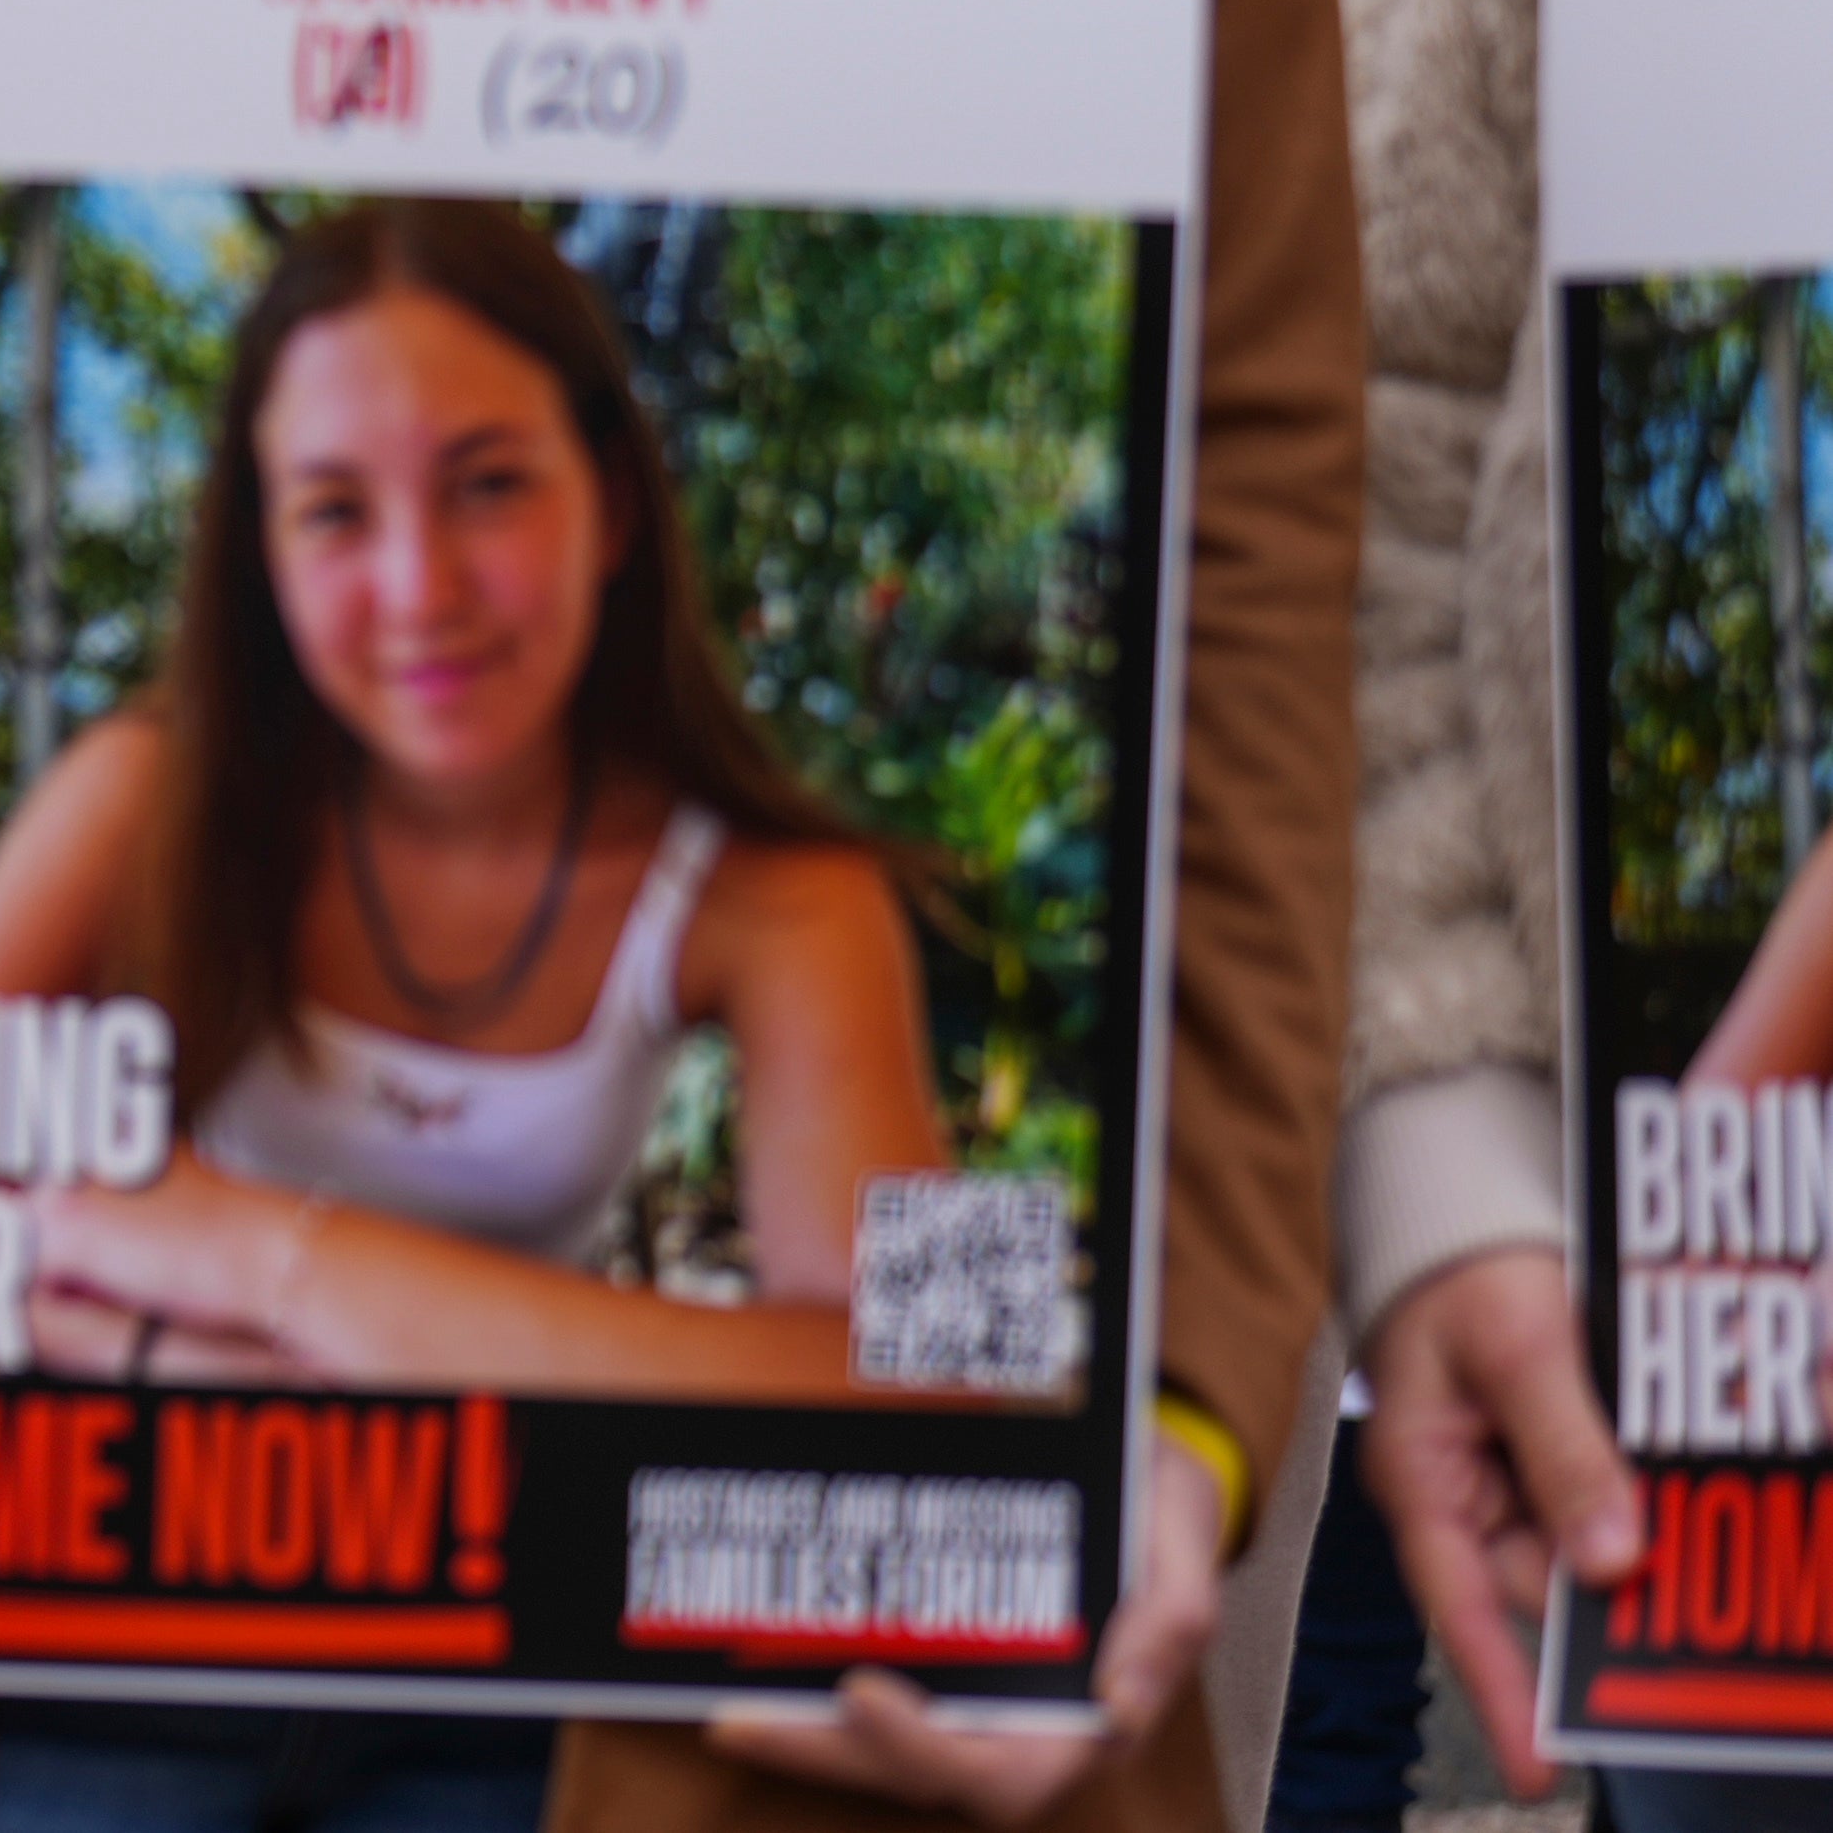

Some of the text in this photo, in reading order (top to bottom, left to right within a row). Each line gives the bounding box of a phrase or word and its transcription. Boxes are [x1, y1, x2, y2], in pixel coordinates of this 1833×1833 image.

[482, 28, 689, 148] (20)
[1617, 1264, 1818, 1457] HER
[150, 1390, 507, 1600] NOW!
[627, 1532, 1081, 1642] FAMILIES FORUM
